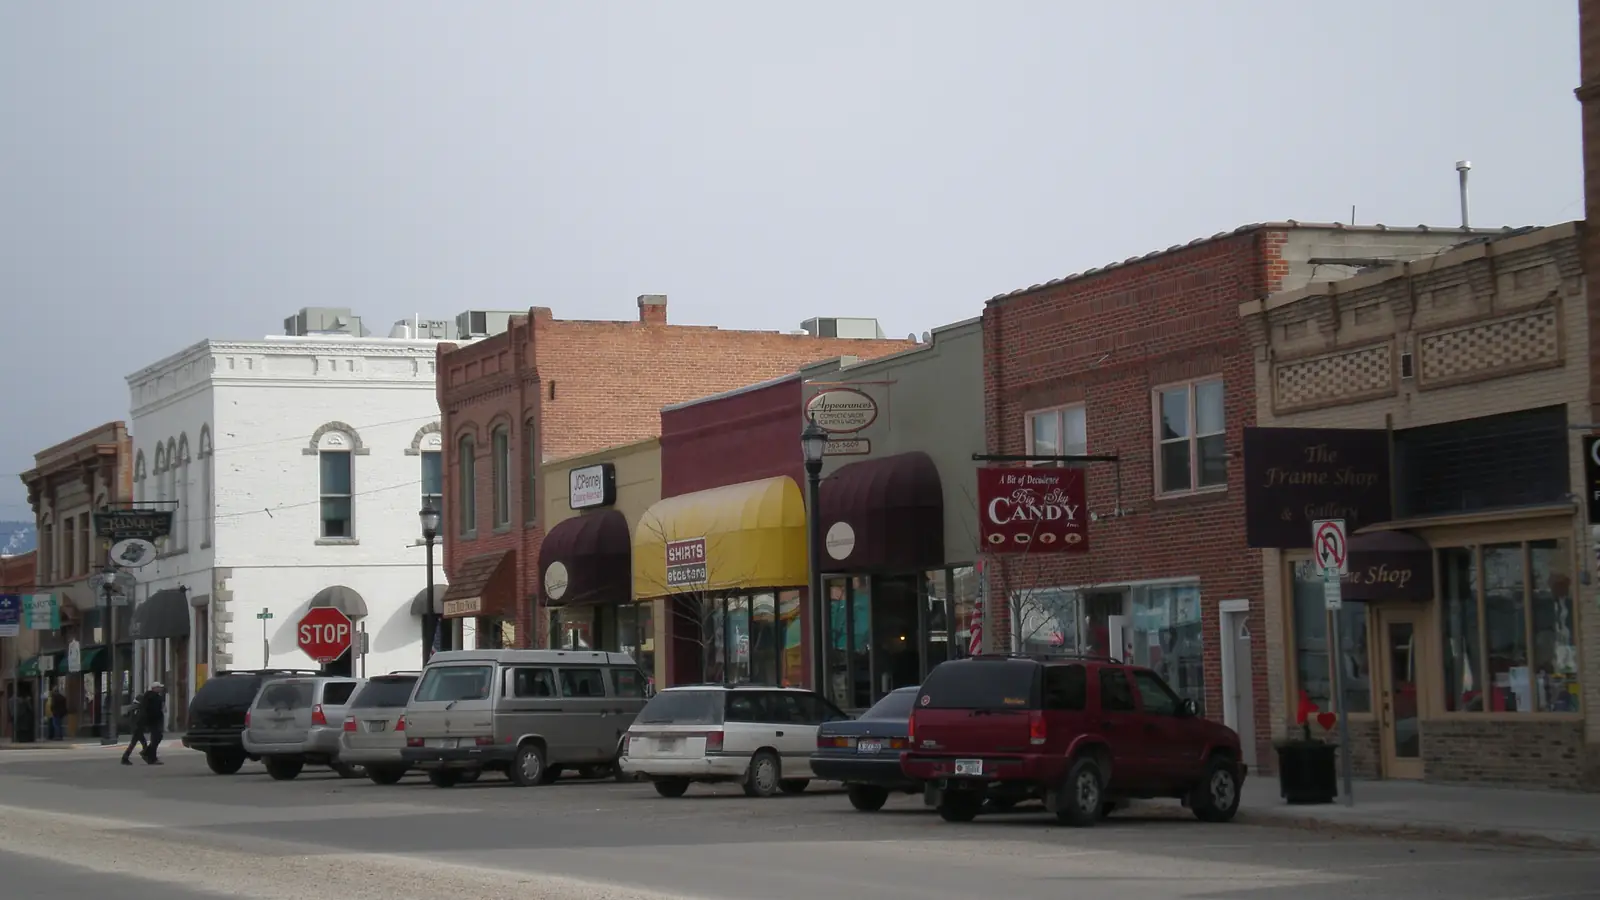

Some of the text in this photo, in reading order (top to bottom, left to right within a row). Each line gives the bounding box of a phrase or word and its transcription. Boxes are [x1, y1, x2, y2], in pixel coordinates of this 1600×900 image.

[811, 395, 871, 412] Appearances
[1304, 444, 1338, 464] The
[574, 474, 602, 491] JCPenney
[999, 474, 1060, 486] A Bit of Decadence
[1263, 466, 1379, 489] Frame Shop
[1009, 488, 1069, 507] Big Sky
[988, 497, 1079, 525] CANDY
[1281, 502, 1359, 521] & Gallery
[669, 543, 703, 561] SHIRTS
[668, 567, 705, 582] etcetera
[1365, 563, 1412, 588] Shop
[300, 624, 348, 644] STOP
